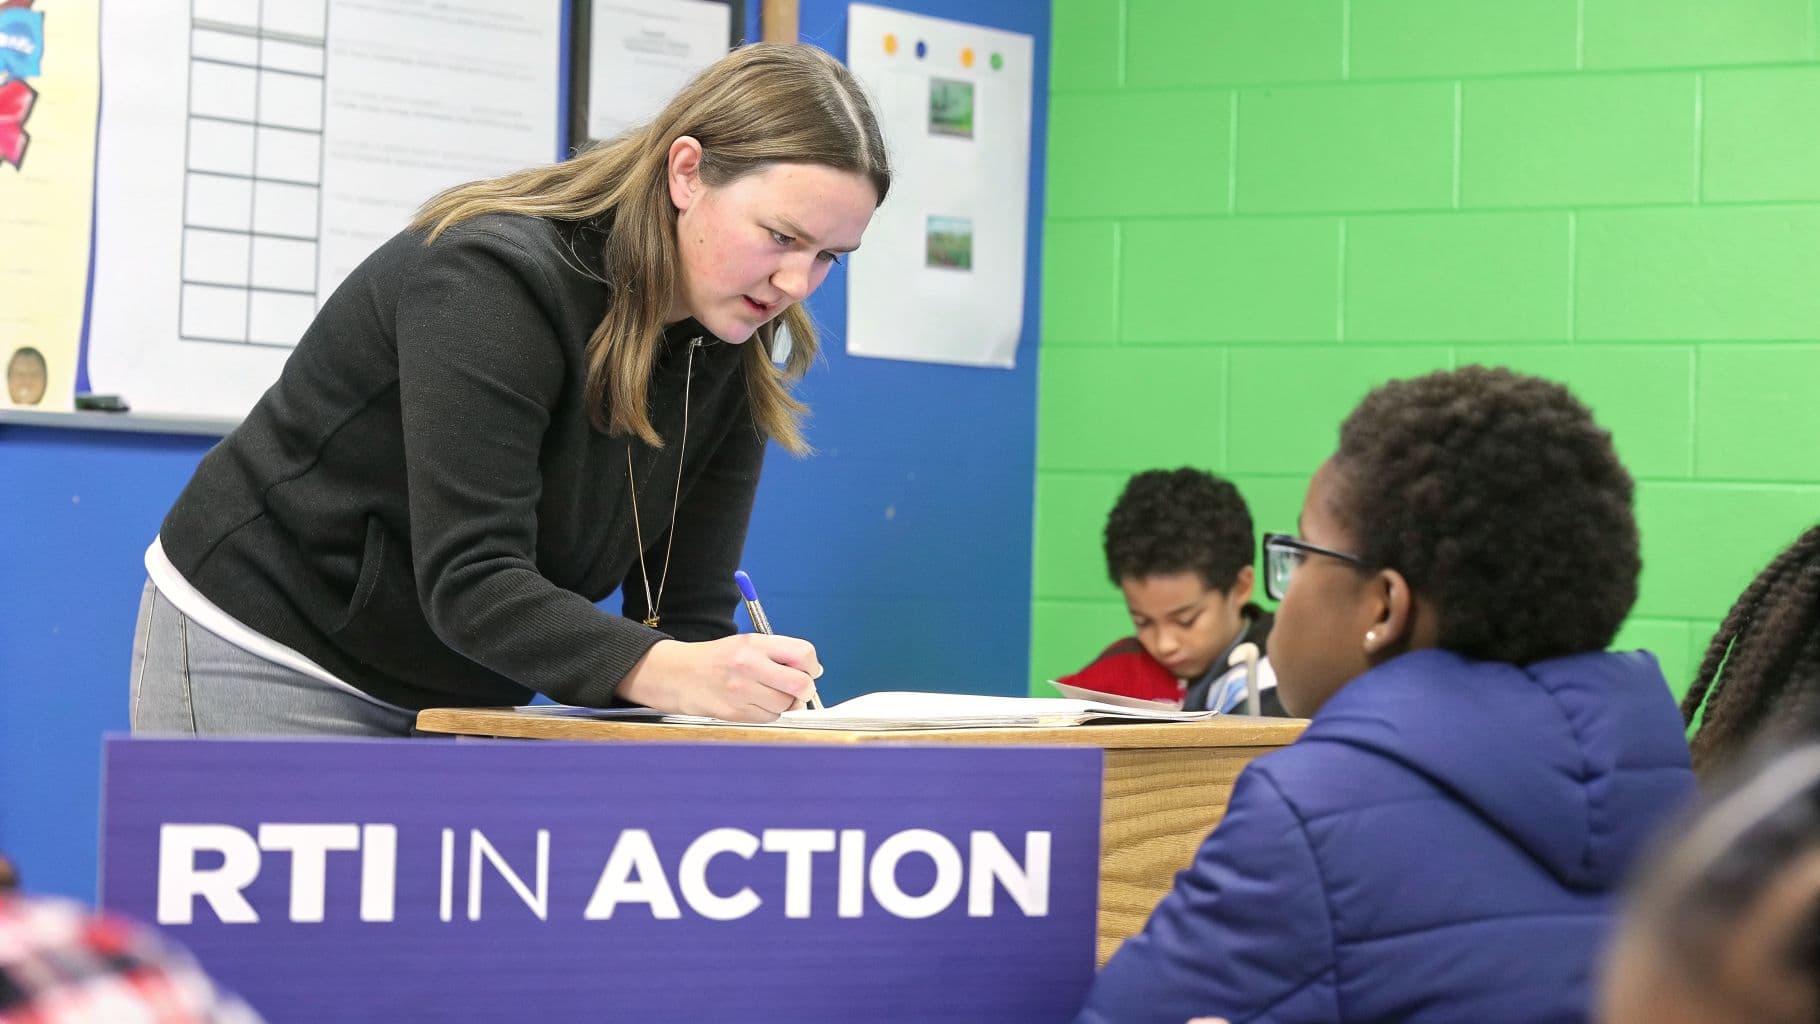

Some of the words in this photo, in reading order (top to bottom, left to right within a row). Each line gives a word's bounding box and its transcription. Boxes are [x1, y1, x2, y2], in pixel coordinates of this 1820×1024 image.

[157, 822, 398, 925] RTI
[439, 827, 551, 923] IN
[584, 826, 1052, 921] ACTION
